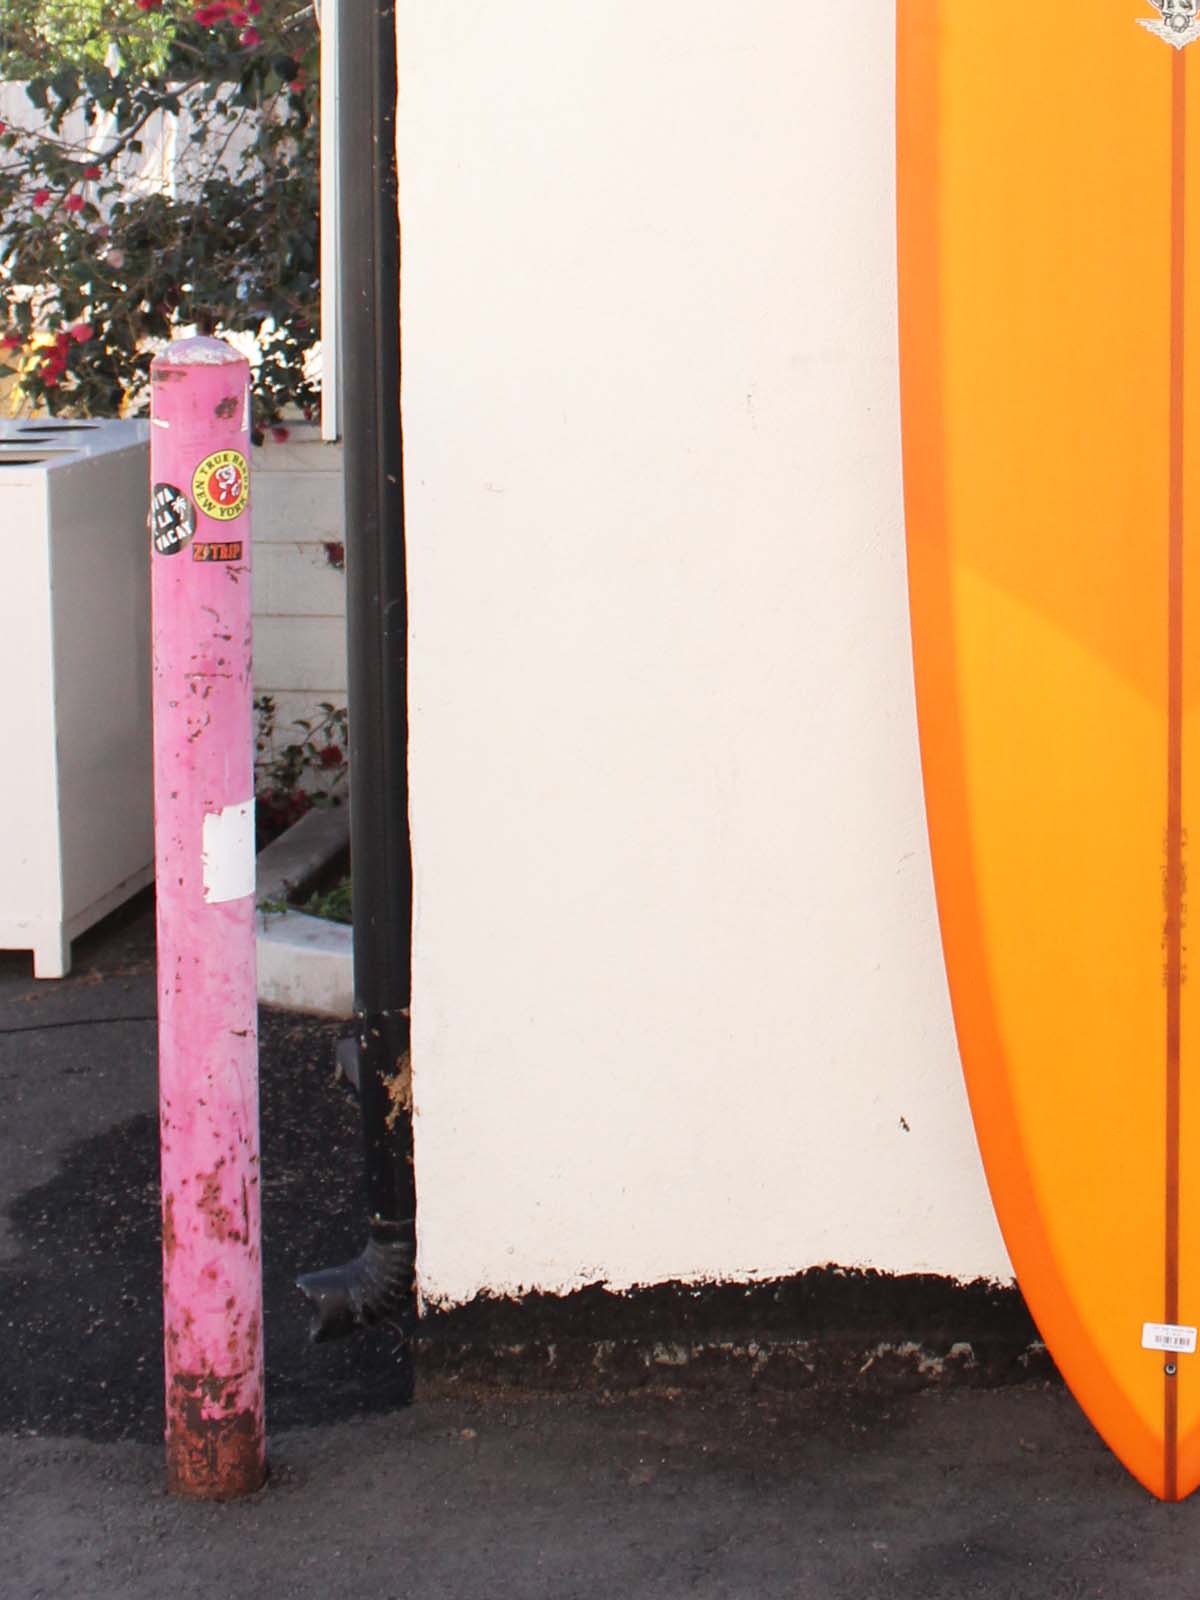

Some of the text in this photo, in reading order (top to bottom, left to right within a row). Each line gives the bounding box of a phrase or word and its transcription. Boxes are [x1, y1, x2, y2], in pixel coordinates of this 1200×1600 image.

[199, 453, 229, 476] TRUE
[153, 487, 173, 510] IVA
[195, 480, 246, 517] NEW YORK
[158, 511, 173, 528] LA
